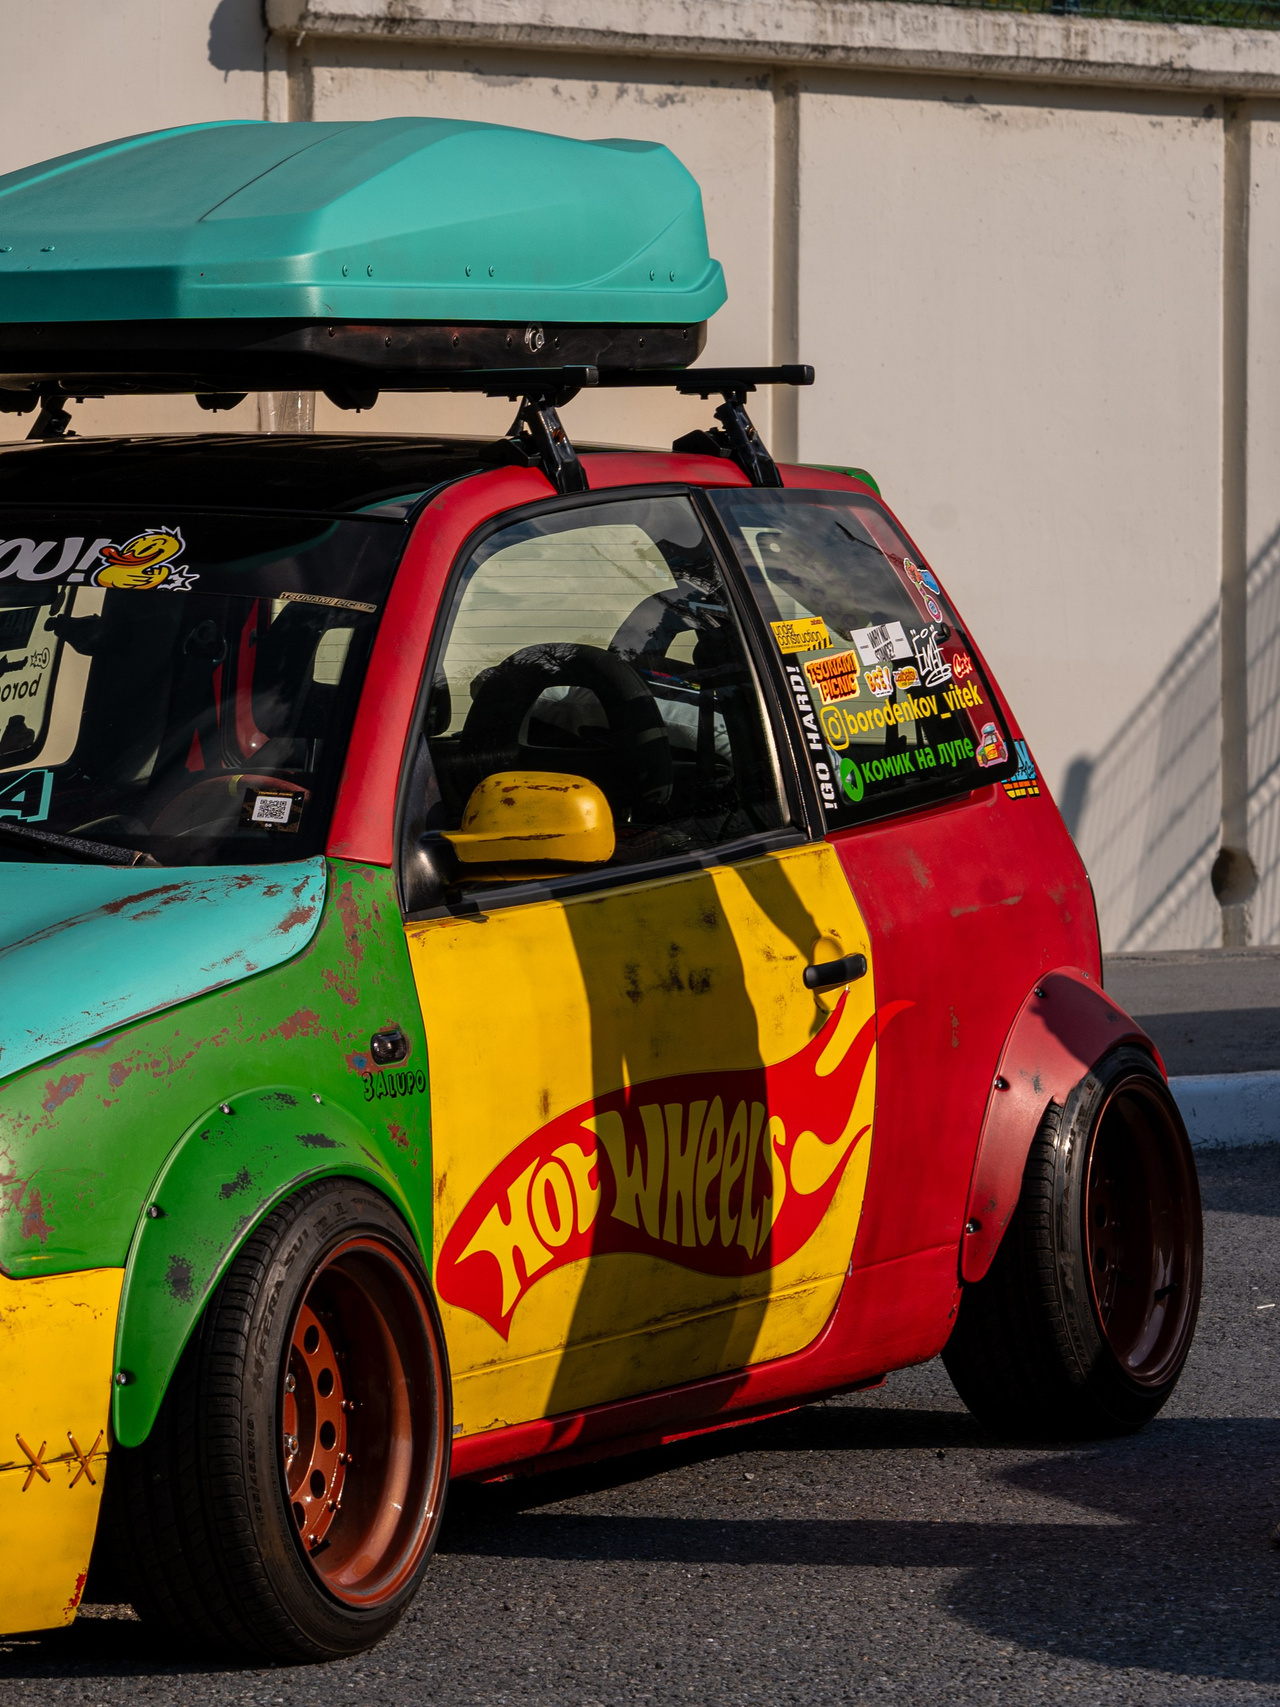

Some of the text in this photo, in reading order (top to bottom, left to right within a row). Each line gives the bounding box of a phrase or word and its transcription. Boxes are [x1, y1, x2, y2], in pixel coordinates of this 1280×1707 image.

[282, 592, 376, 611] TSUNAMI PICNIC
[773, 622, 794, 636] under
[777, 629, 823, 646] construction
[867, 626, 882, 649] WHY
[806, 652, 857, 684] TSUNAMI
[820, 672, 857, 702] PICNIC
[786, 665, 823, 750] HARD!
[842, 680, 984, 735] borodenkov_vitek
[861, 752, 915, 784] комик
[914, 745, 937, 770] на
[936, 737, 975, 768] лупе
[453, 1094, 787, 1318] HOT WHEELS
